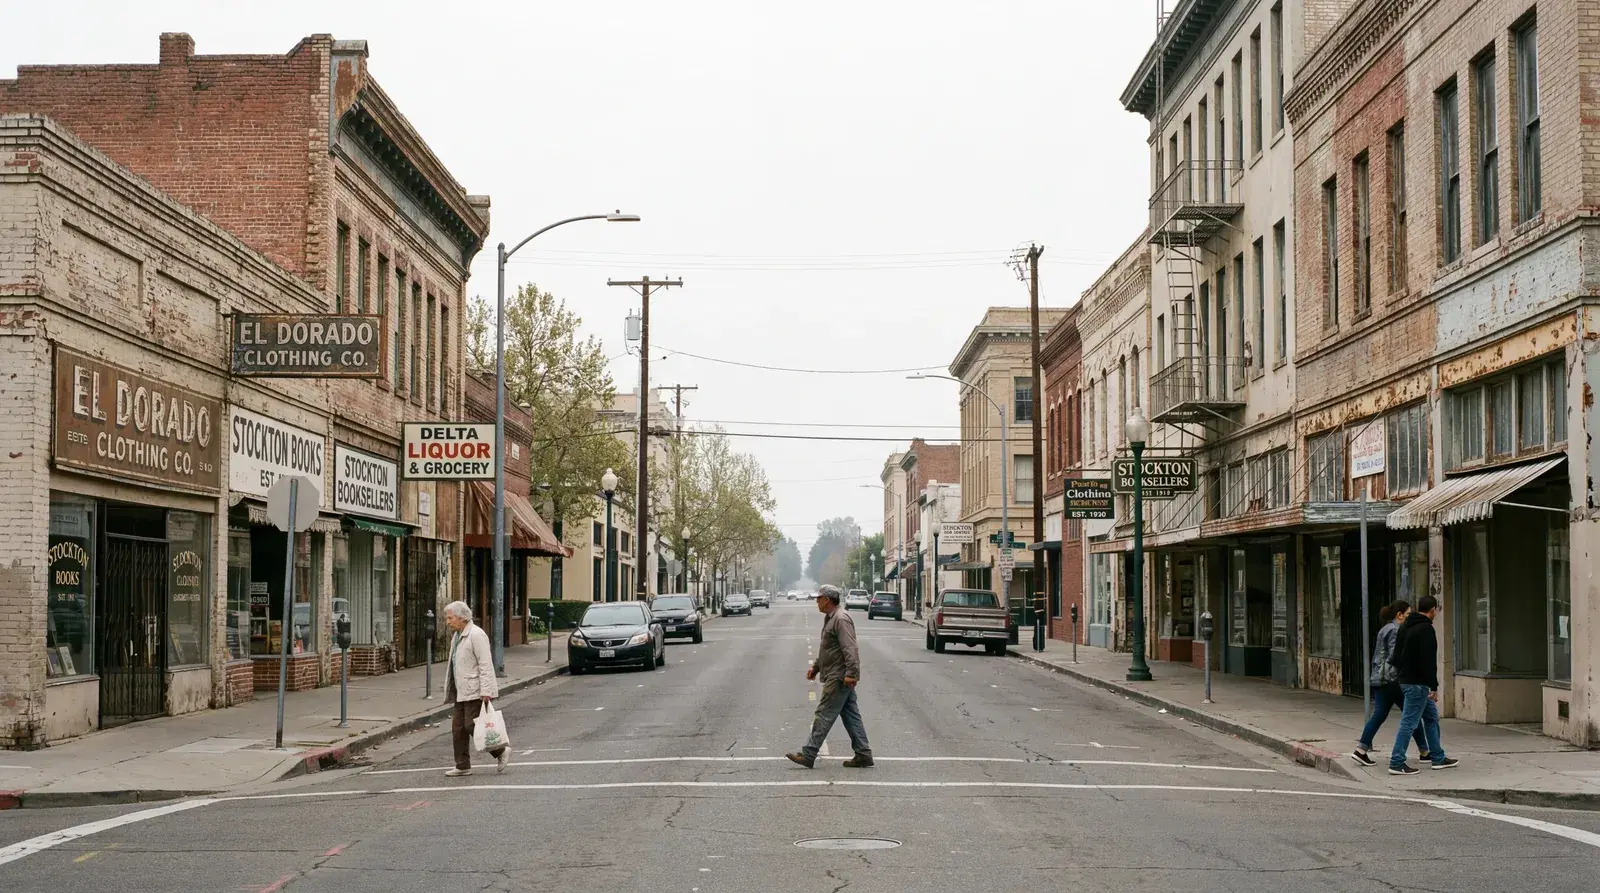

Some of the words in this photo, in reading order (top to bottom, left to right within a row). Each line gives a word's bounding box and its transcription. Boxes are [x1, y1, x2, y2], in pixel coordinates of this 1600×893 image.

[240, 322, 268, 345] EL
[277, 322, 374, 346] DORADO
[243, 350, 332, 367] CLOTHING
[340, 350, 369, 367] CO.
[73, 365, 107, 421] EL
[116, 380, 211, 448] DORADO
[420, 427, 479, 440] DELTA
[96, 432, 169, 472] CLOTHING
[174, 450, 194, 475] CO.
[232, 415, 288, 467] STOCKTON
[292, 434, 322, 476] BOOKS
[408, 442, 491, 460] LIQUOR
[345, 454, 389, 487] STOCKTON
[409, 462, 420, 474] &
[424, 461, 490, 475] GROCERY
[1118, 462, 1191, 476] STCKTON
[1121, 476, 1189, 487] BOKSELLERS
[338, 480, 394, 513] BOOKSELLERS
[48, 541, 90, 570] STOCKTON
[55, 570, 80, 586] BOOKS
